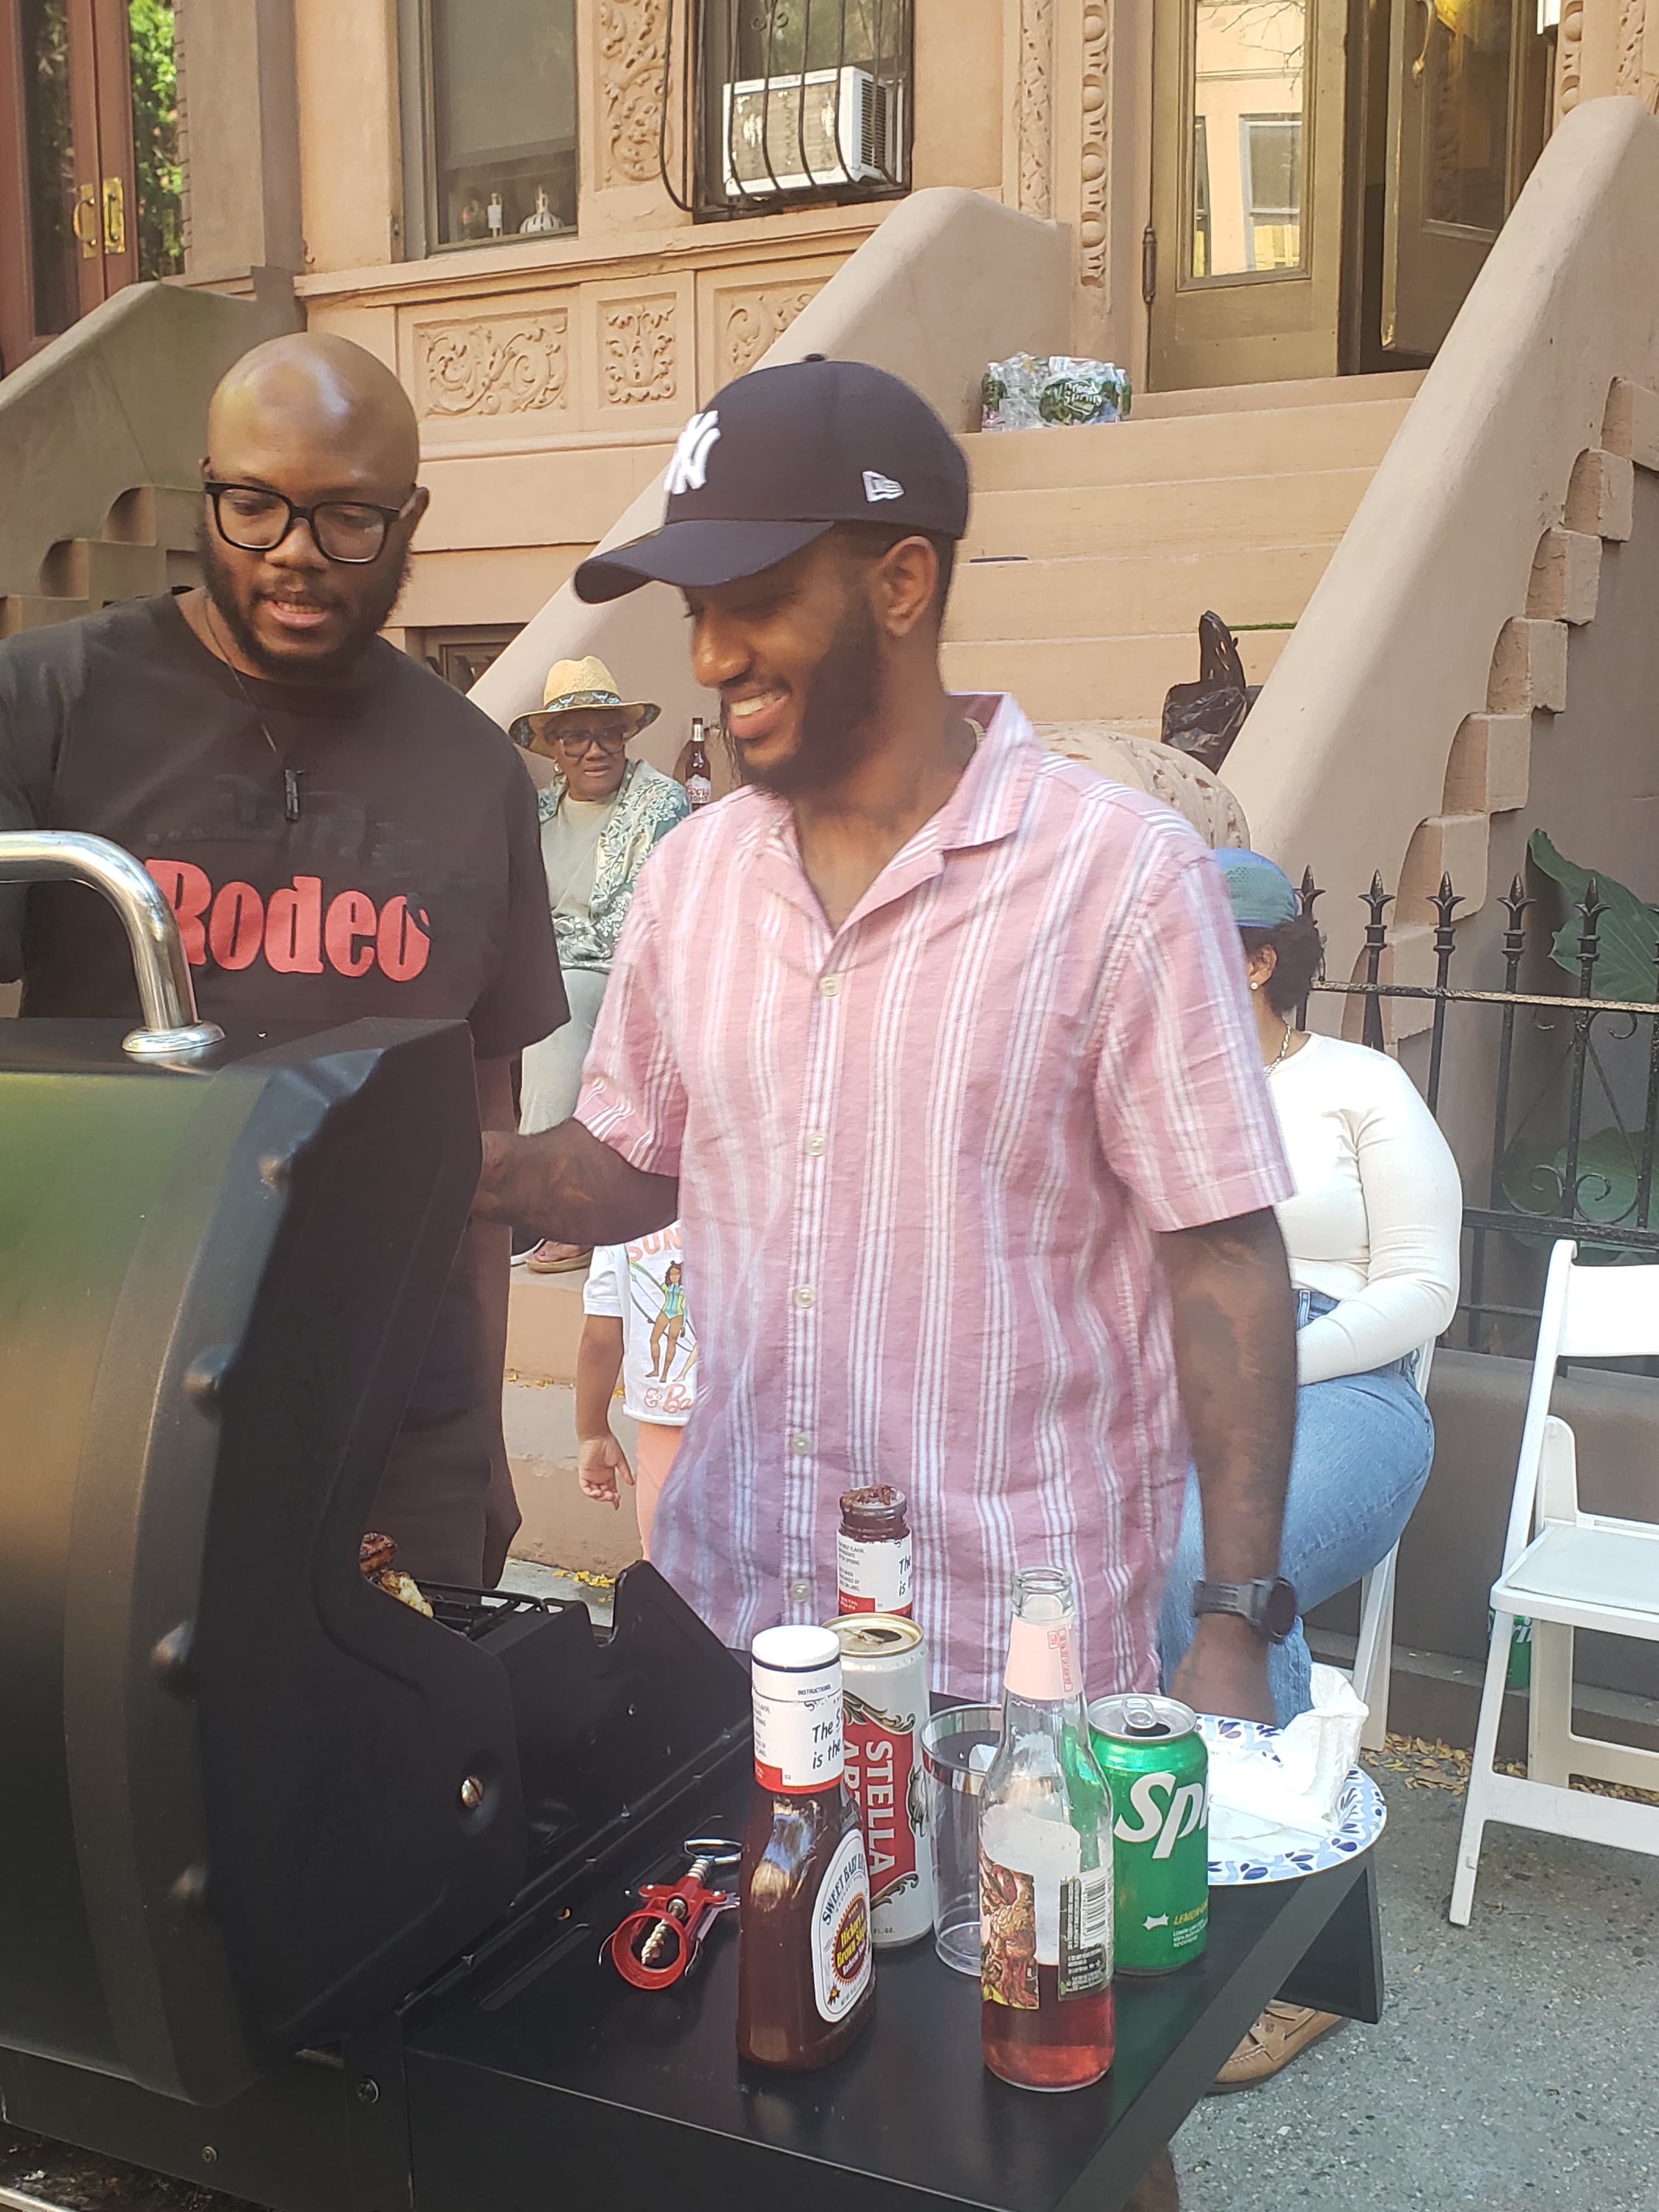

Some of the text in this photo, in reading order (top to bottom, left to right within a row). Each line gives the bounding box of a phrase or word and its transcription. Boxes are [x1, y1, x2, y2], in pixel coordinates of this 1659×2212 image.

[145, 859, 431, 982] Rodeo
[798, 1684, 831, 1696] INSTRUCTIONS
[812, 1721, 834, 1743] The
[812, 1738, 841, 1769] is the
[866, 1740, 895, 1876] STELLA
[822, 1874, 844, 1926] SWEET
[837, 1939, 856, 1968] Brown
